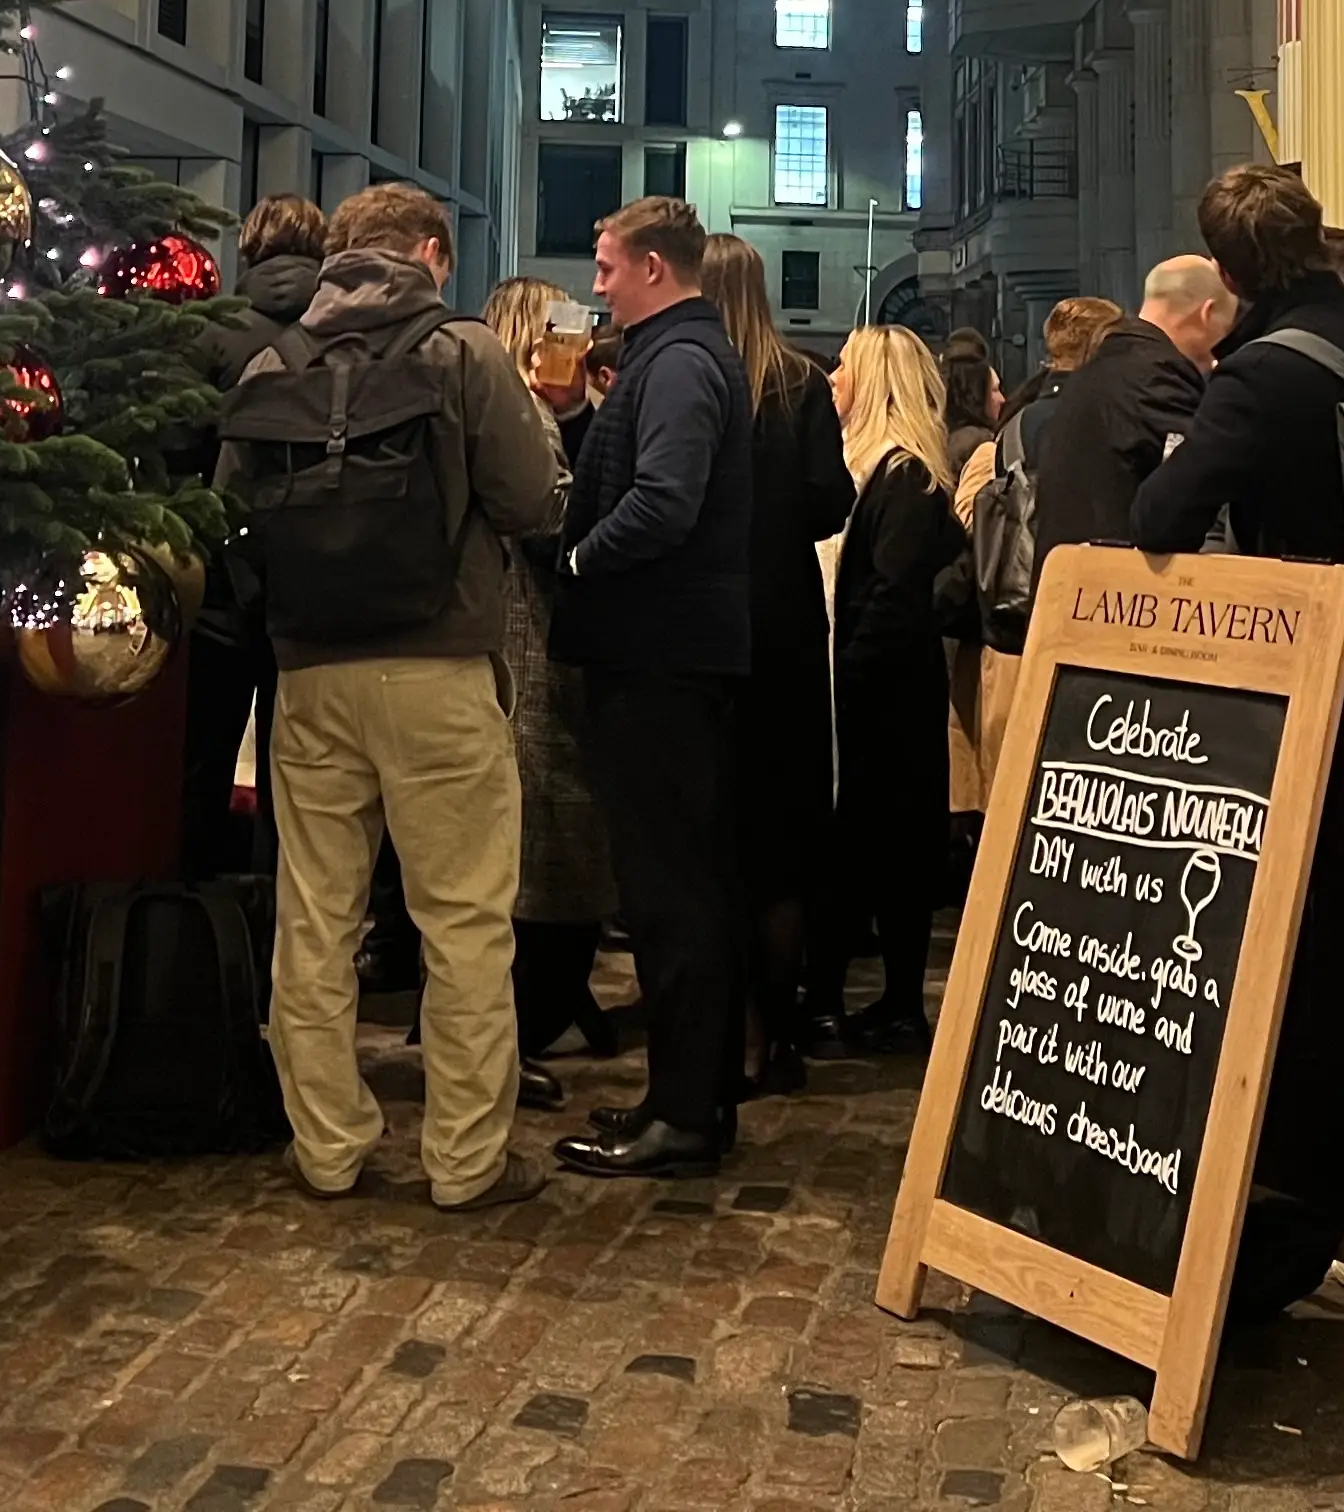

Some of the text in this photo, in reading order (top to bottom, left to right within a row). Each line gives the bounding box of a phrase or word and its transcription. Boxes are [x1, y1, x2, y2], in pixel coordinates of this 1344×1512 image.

[1071, 587, 1301, 646] LAMB TAVERN
[1178, 576, 1195, 587] THE
[1086, 693, 1209, 764] Celebrate
[1037, 770, 1264, 852] BEAUJOLAIS NOUVEAU
[1029, 831, 1164, 904] DAY with us
[1013, 901, 1071, 959] Come
[1150, 957, 1198, 1010] grab
[1204, 978, 1221, 1009] a
[1006, 955, 1195, 1055] glass of wine and
[995, 1019, 1146, 1094] pair it with our
[980, 1065, 1182, 1195] delicious cheeseboard
